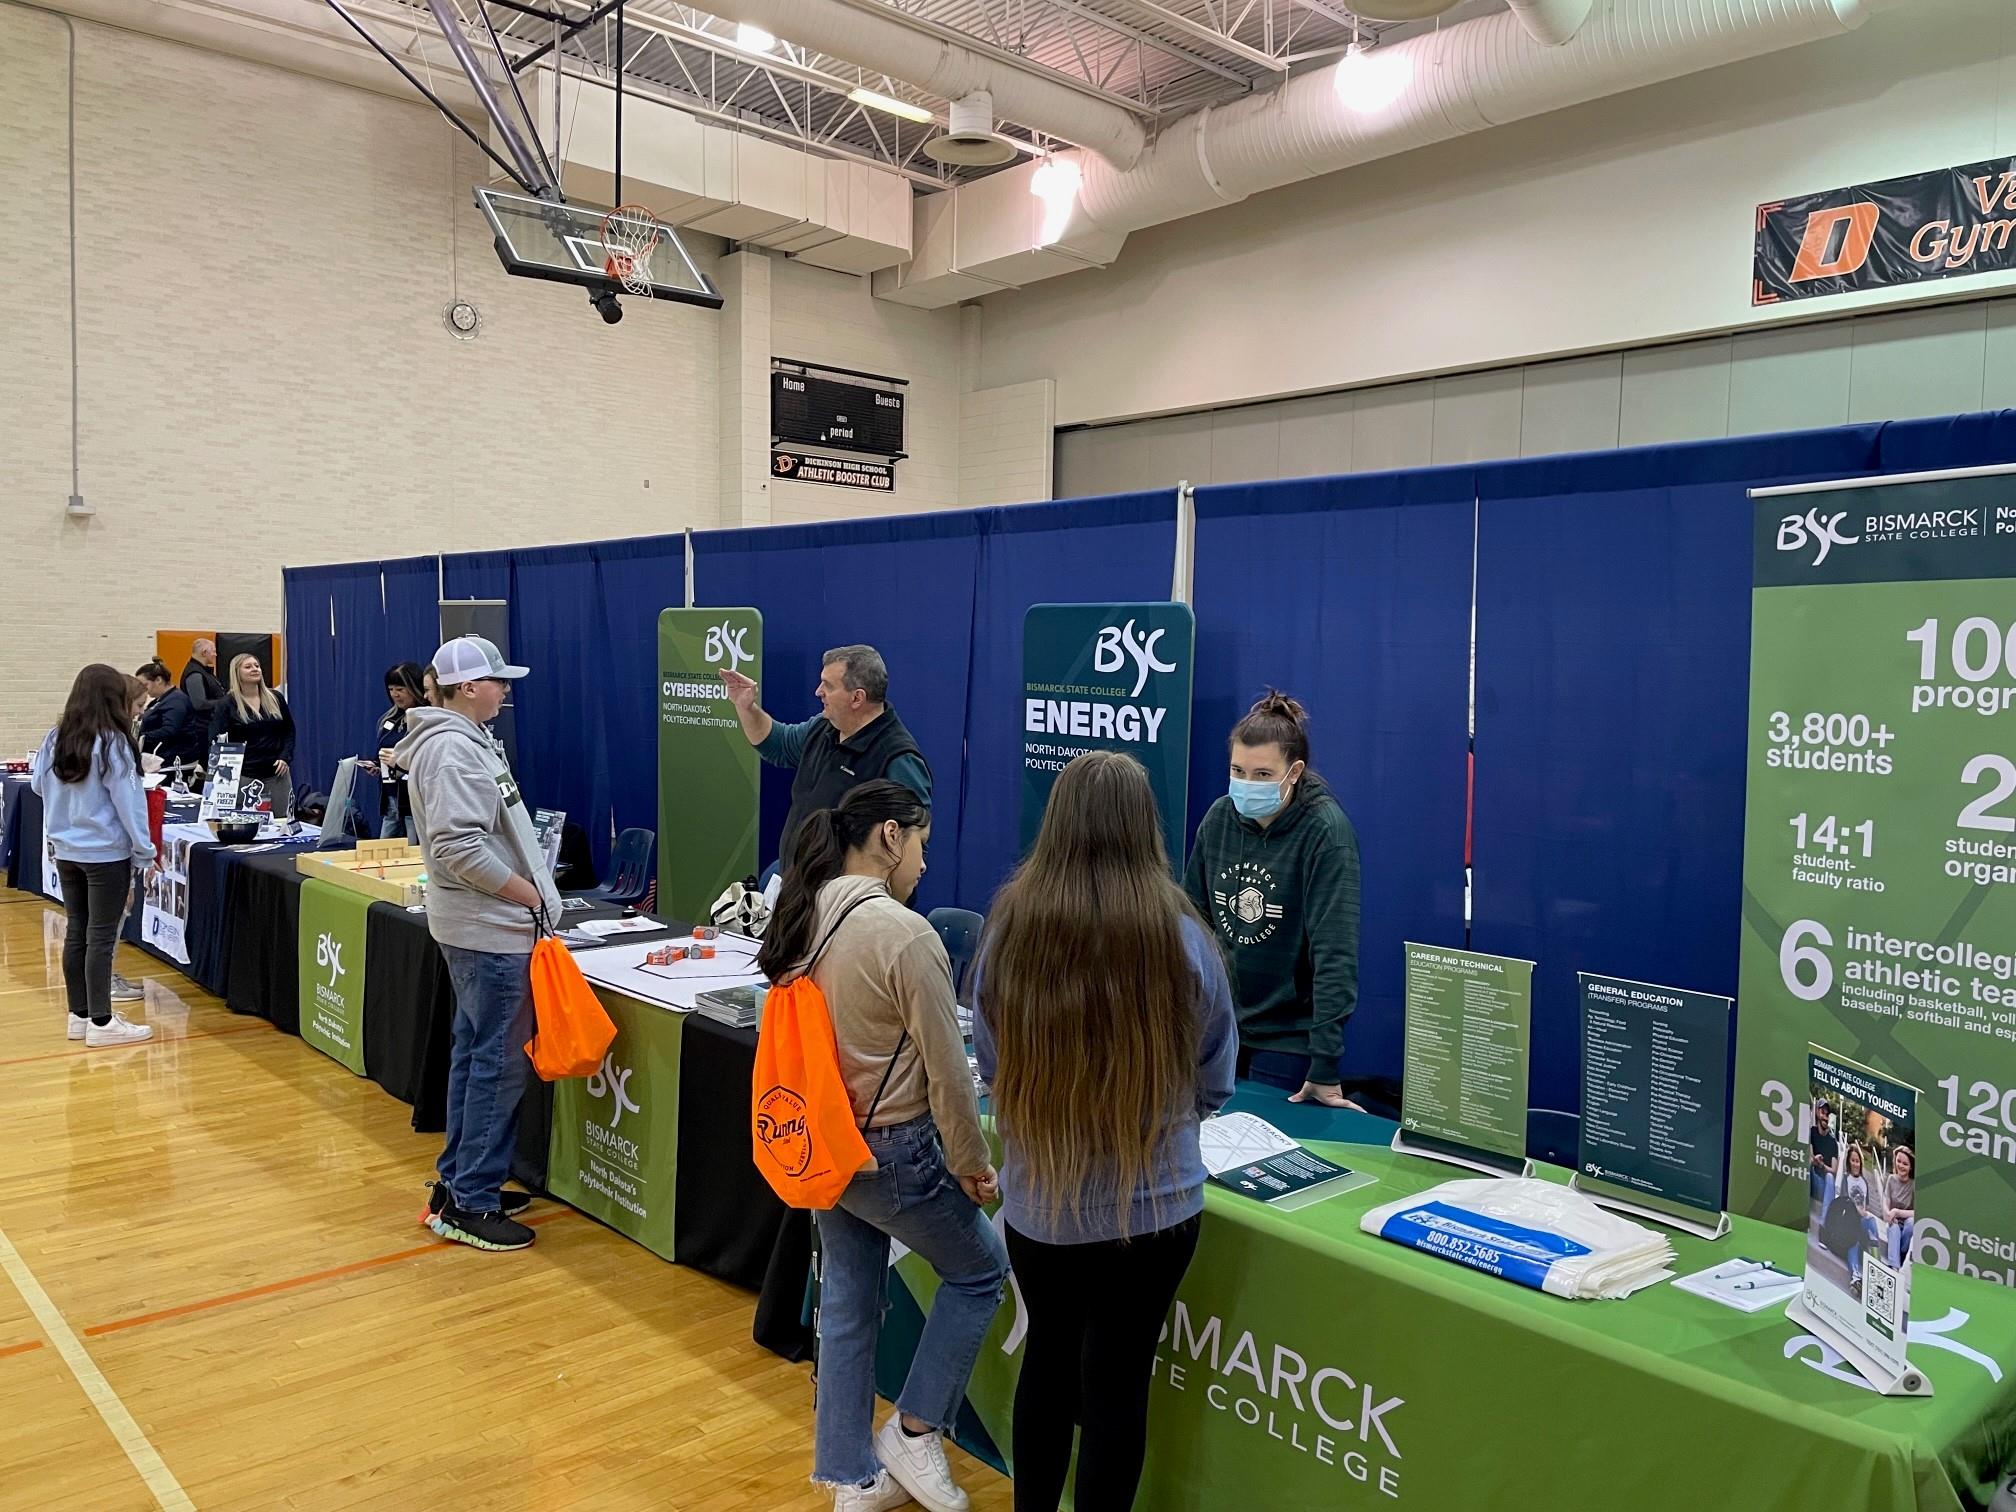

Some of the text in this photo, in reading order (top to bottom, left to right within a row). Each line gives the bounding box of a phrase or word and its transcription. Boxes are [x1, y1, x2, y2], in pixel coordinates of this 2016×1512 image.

[1788, 201, 1880, 283] D
[1909, 218, 2016, 269] Gym
[783, 376, 805, 393] Home
[875, 393, 900, 409] Guests
[830, 427, 854, 439] period
[797, 466, 890, 488] ATHLETIC BOOSTER CLUB
[804, 457, 888, 475] DICKINSON HIGH SCHOOL
[1865, 508, 1979, 533] BISMARCK
[1865, 526, 1979, 543] STATE COLLEGE
[1906, 616, 2016, 682] 10
[663, 681, 729, 700] CYBERSECU
[1026, 682, 1127, 697] BISMARCK STATE COLLEGE
[1911, 685, 2016, 715] progr
[662, 714, 738, 729] POLYTECHNIC INSTITUTION
[663, 702, 711, 714] NORTH DAKOTA'S
[1025, 698, 1167, 743] ENERGY
[1768, 711, 1895, 749] 3,800+
[1025, 742, 1092, 758] NORTH DAKOT
[1025, 757, 1067, 772] POLYTECH
[1766, 745, 1893, 775] students
[1789, 812, 1873, 858] 14:1
[1221, 862, 1276, 891] BISMARCK
[1793, 854, 1857, 871] student-
[1792, 867, 1885, 892] faculty ratio
[1238, 923, 1276, 944] COLLEGE
[1410, 951, 1504, 973] CAREER AND TECHNICAL
[1410, 960, 1443, 971] EDUCATION
[1780, 919, 1833, 1001] 6
[316, 982, 345, 1009] BISMARCK
[1588, 983, 1683, 1007] GENERAL EDUCATION
[1844, 959, 2016, 1005] athletic tea
[1587, 992, 1668, 1013] (TRANSFER) PROGRAMS
[1841, 982, 2016, 1026] including basketball, voll
[1841, 996, 1903, 1018] baseball,
[1907, 1008, 1960, 1029] softball
[1964, 1020, 1991, 1034] and
[1813, 1058, 1876, 1092] BISMARCK STATE COLLEGE
[1813, 1067, 1908, 1119] TELL US ABOUT YOURSELF
[586, 1119, 639, 1161] BISMARCK
[1756, 1133, 1806, 1163] largest
[606, 1148, 639, 1171] COLLEGE
[1755, 1150, 1768, 1167] in
[590, 1159, 637, 1196] North Dakota's
[579, 1170, 647, 1219] Polytechnic Institution
[1416, 1239, 1504, 1276] bismarckstate.edu/energy
[1426, 1230, 1500, 1264] 800.852.5685
[1912, 1217, 1951, 1272] 6
[1157, 1300, 1405, 1459] MARCK
[1206, 1383, 1400, 1499] COLLEGE
